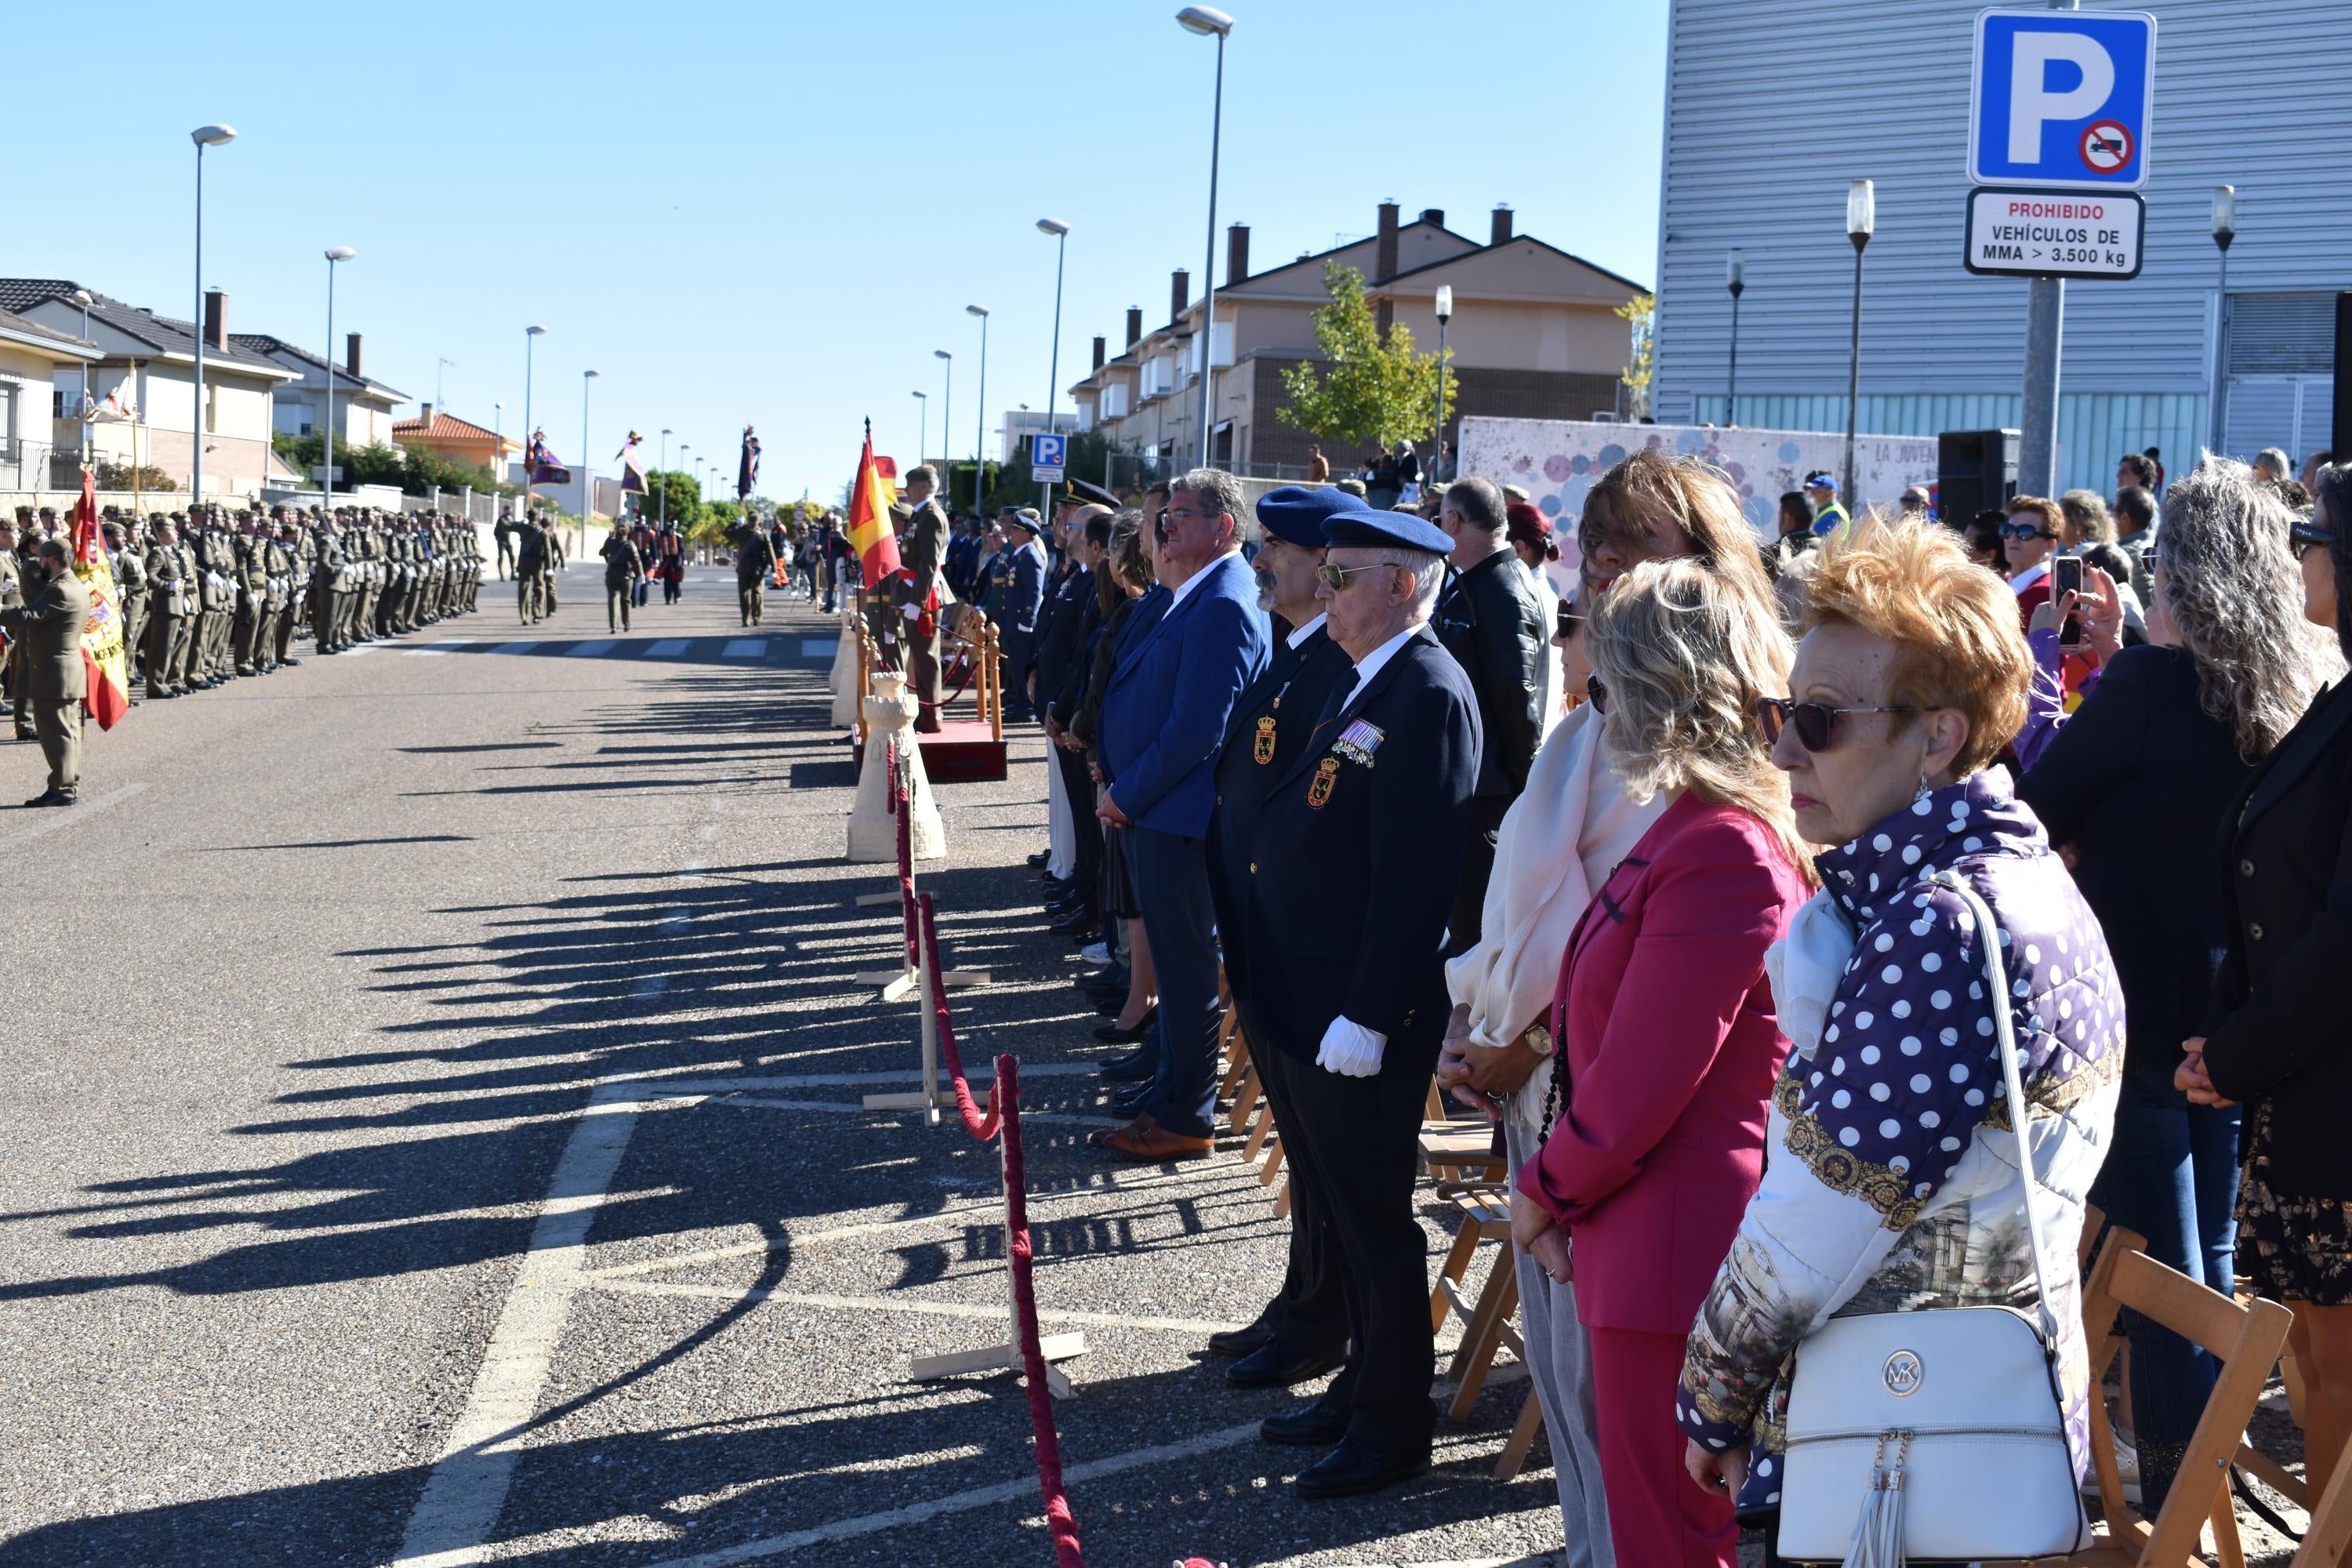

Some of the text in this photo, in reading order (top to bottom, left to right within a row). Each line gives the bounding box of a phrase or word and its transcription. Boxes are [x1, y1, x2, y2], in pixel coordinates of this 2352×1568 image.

[2008, 31, 2115, 164] P
[2009, 202, 2104, 220] PROHIBIDO
[1992, 223, 2119, 245] VEHÍCULOS DE
[1983, 245, 2023, 261] MMA
[2051, 248, 2098, 263] 3.500
[2106, 249, 2125, 267] kg
[1039, 437, 1060, 463] P
[1875, 443, 1937, 463] LA JUVEN
[1888, 1362, 1918, 1383] MK
